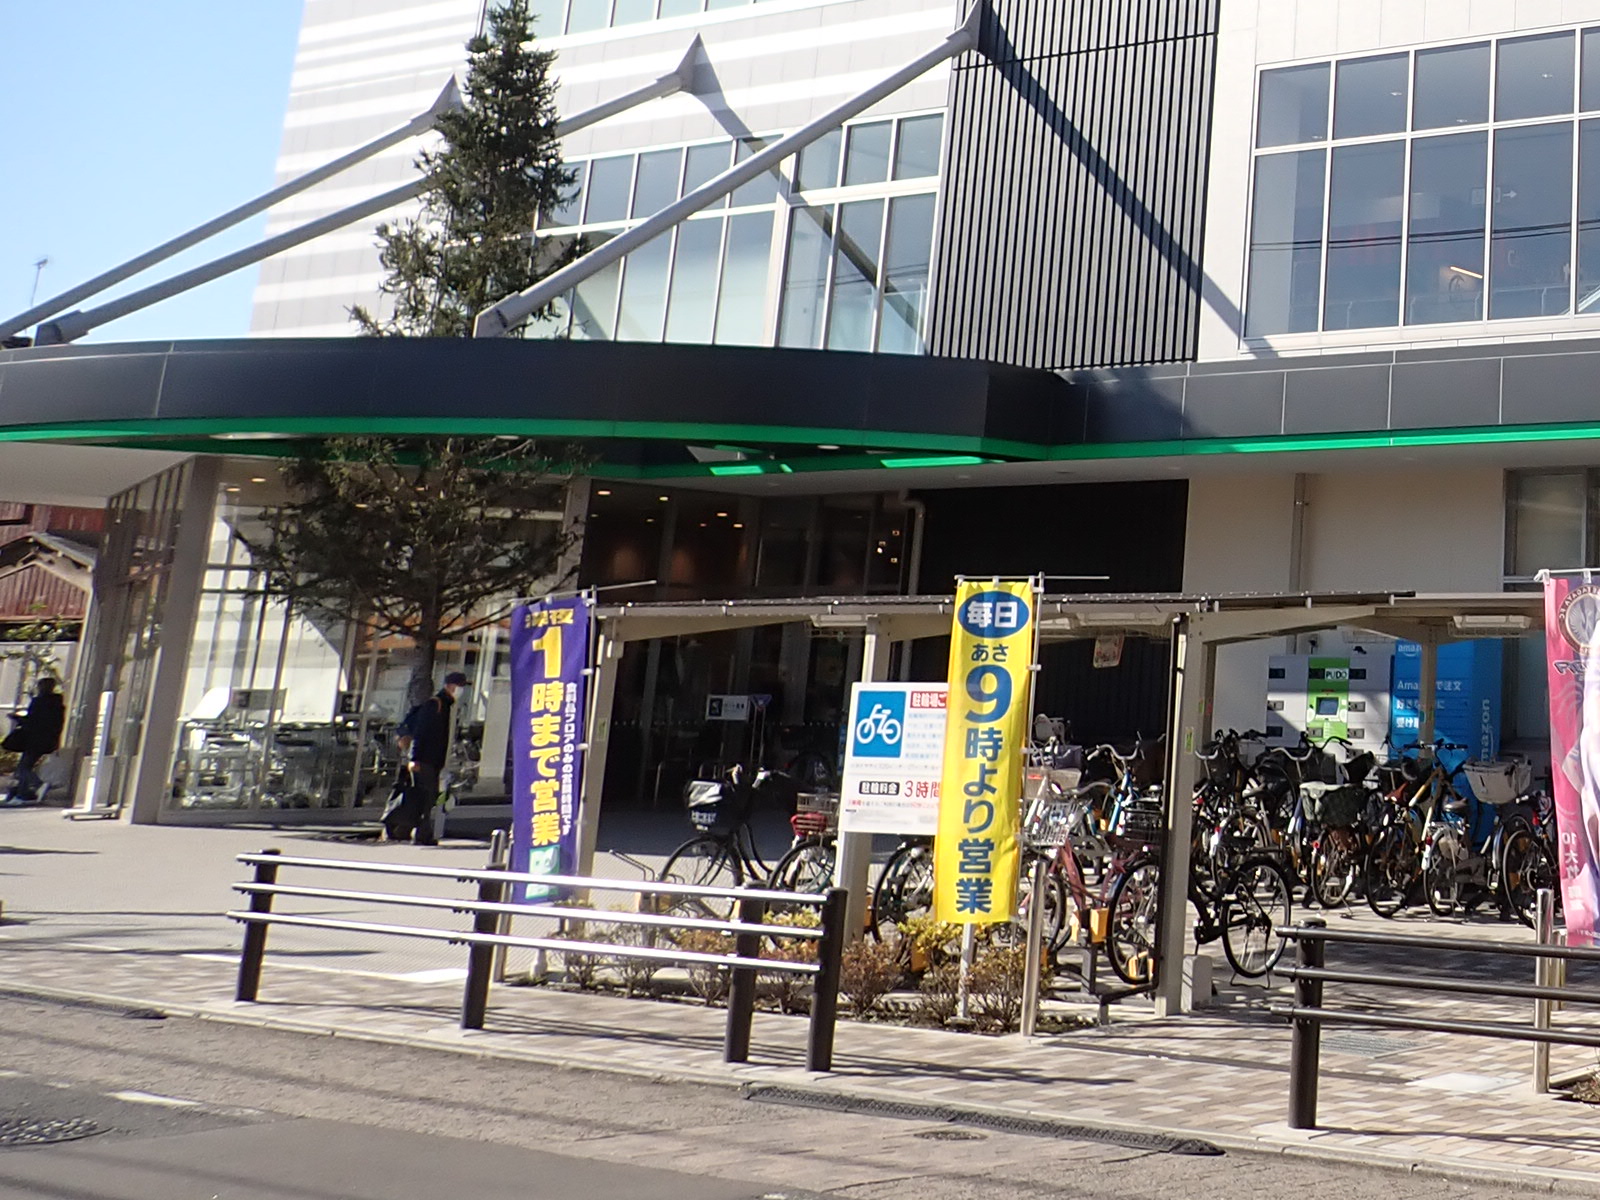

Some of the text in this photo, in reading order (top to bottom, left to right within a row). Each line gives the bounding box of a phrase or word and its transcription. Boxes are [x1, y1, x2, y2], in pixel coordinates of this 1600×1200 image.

[967, 601, 1018, 628] 毎日
[971, 643, 1008, 662] あさ
[1326, 670, 1348, 680] PUDO
